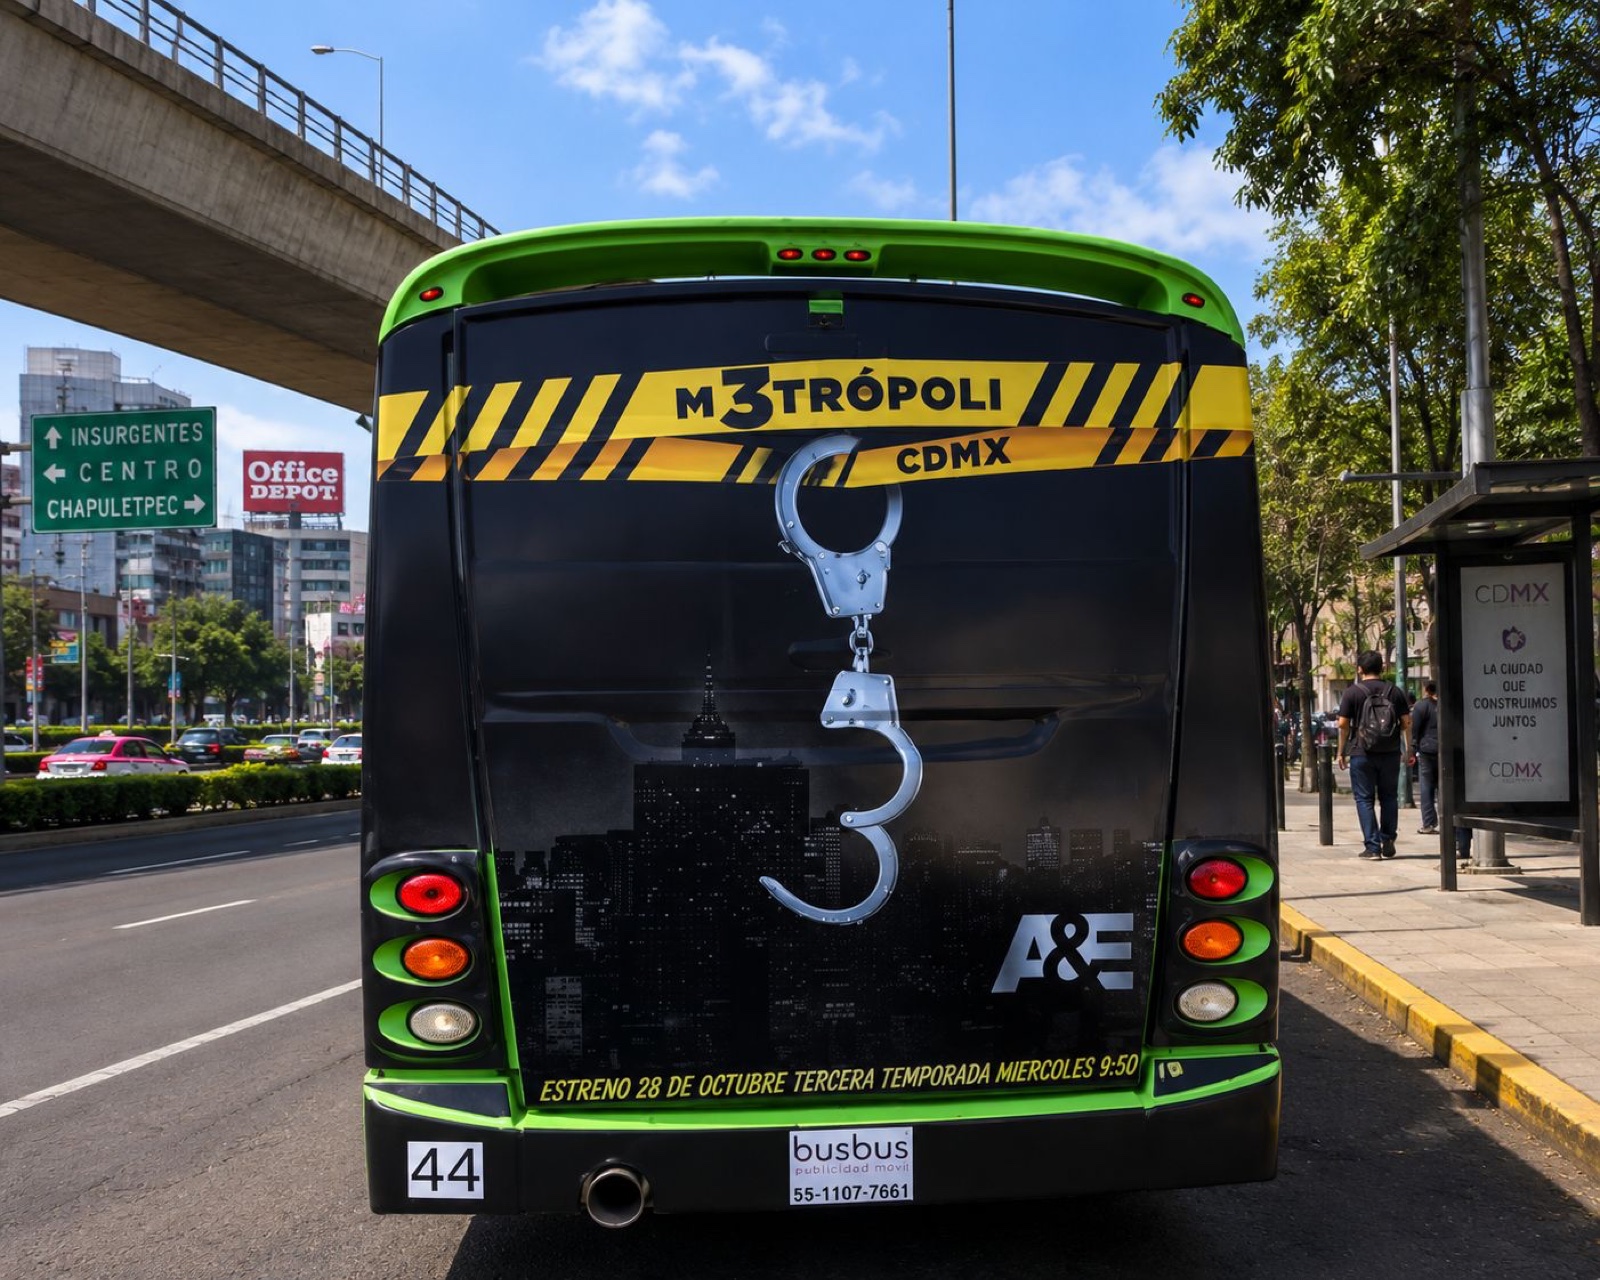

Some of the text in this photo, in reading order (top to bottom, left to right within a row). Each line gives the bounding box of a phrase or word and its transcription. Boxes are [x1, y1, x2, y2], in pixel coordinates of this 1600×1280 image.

[675, 366, 1002, 430] M3TRÓPOLI
[71, 422, 204, 447] INSURGENTES
[896, 436, 1012, 474] CDMX
[79, 458, 202, 483] CENTRO
[248, 460, 339, 484] Office
[47, 495, 179, 519] CHAPULETPEC
[1475, 582, 1550, 604] CDMX
[1483, 663, 1544, 675] LA CIUDAD
[1502, 680, 1526, 693] QUE
[1473, 697, 1558, 710] CONSTRUIMOS
[1492, 715, 1537, 728] JUNTOS
[1489, 761, 1543, 778] CDMX
[991, 912, 1134, 994] A&E
[540, 1053, 1139, 1101] ESTRENO 28 DE OCTUBRE TERCERA TEMPORADA MIERCOLES 9:50
[793, 1133, 909, 1162] busbus
[411, 1147, 480, 1192] 44
[795, 1164, 869, 1176] publicidad
[793, 1183, 909, 1202] 55-1107-7661
